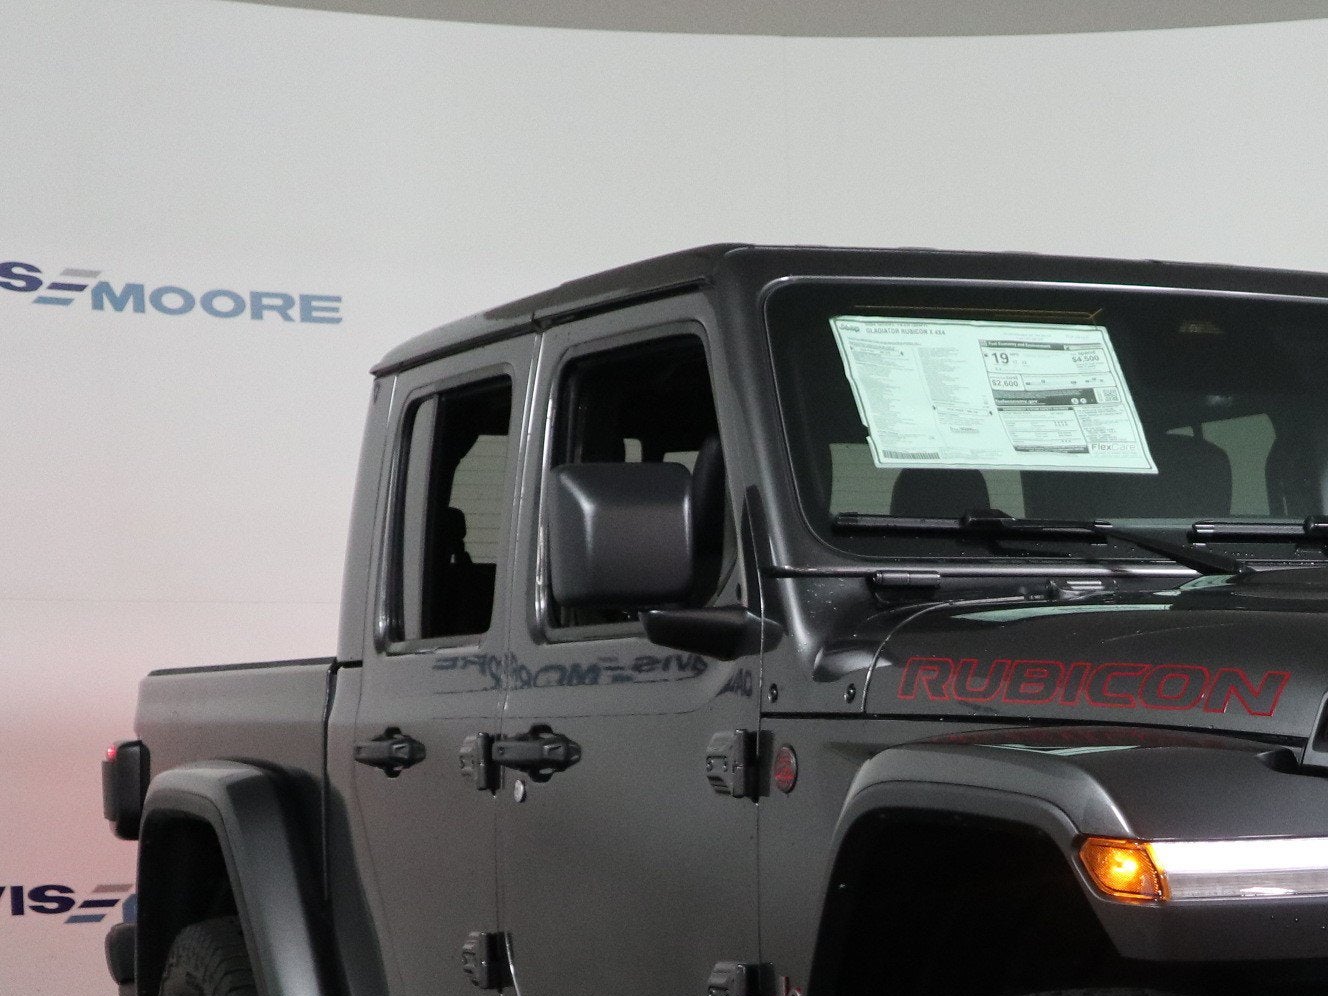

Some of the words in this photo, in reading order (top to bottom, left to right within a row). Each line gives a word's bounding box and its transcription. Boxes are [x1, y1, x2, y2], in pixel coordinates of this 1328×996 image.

[90, 281, 343, 324] MOORE
[992, 352, 1010, 365] 19
[991, 379, 1019, 388] $2,600
[1091, 442, 1136, 452] FlexCare
[898, 656, 1291, 718] RUBICON
